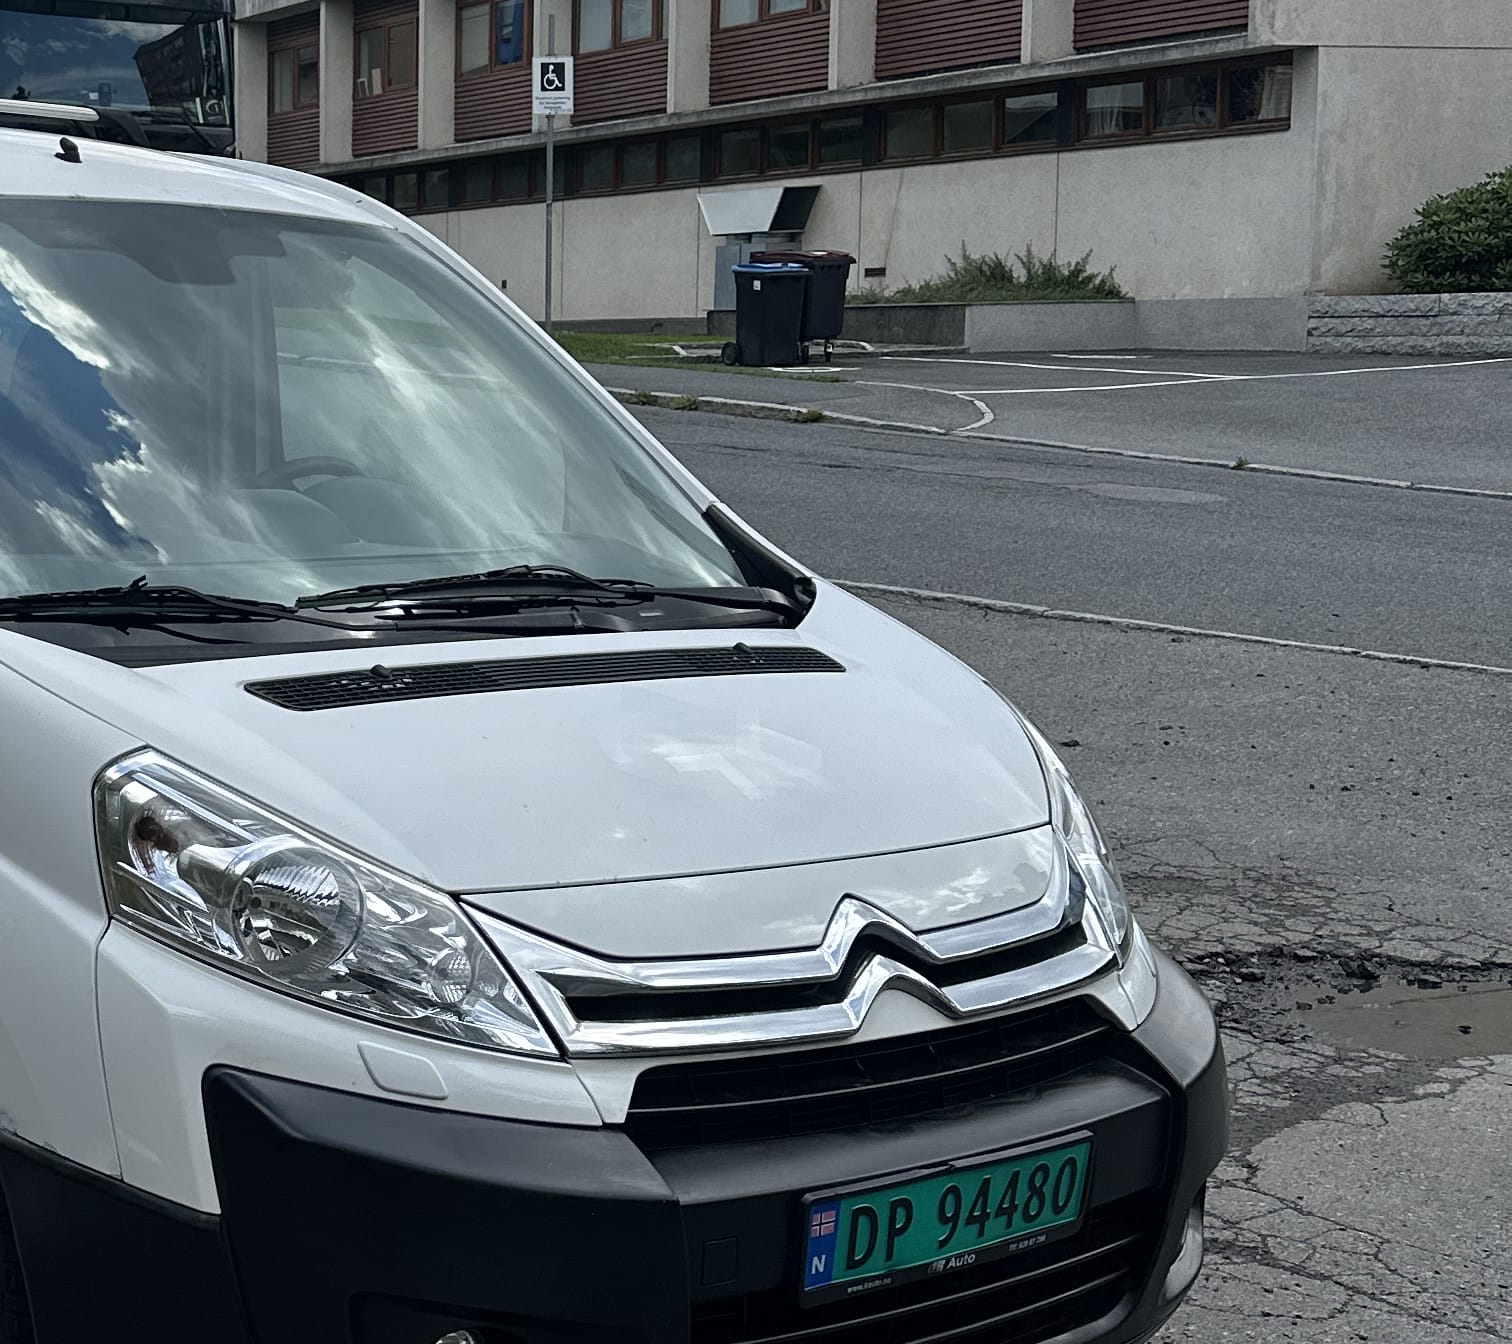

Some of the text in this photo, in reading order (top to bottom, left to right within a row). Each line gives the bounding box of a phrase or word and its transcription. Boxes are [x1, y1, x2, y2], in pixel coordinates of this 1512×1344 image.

[845, 1156, 1078, 1271] DP 94480
[810, 1254, 826, 1275] N
[947, 1253, 976, 1269] Auto
